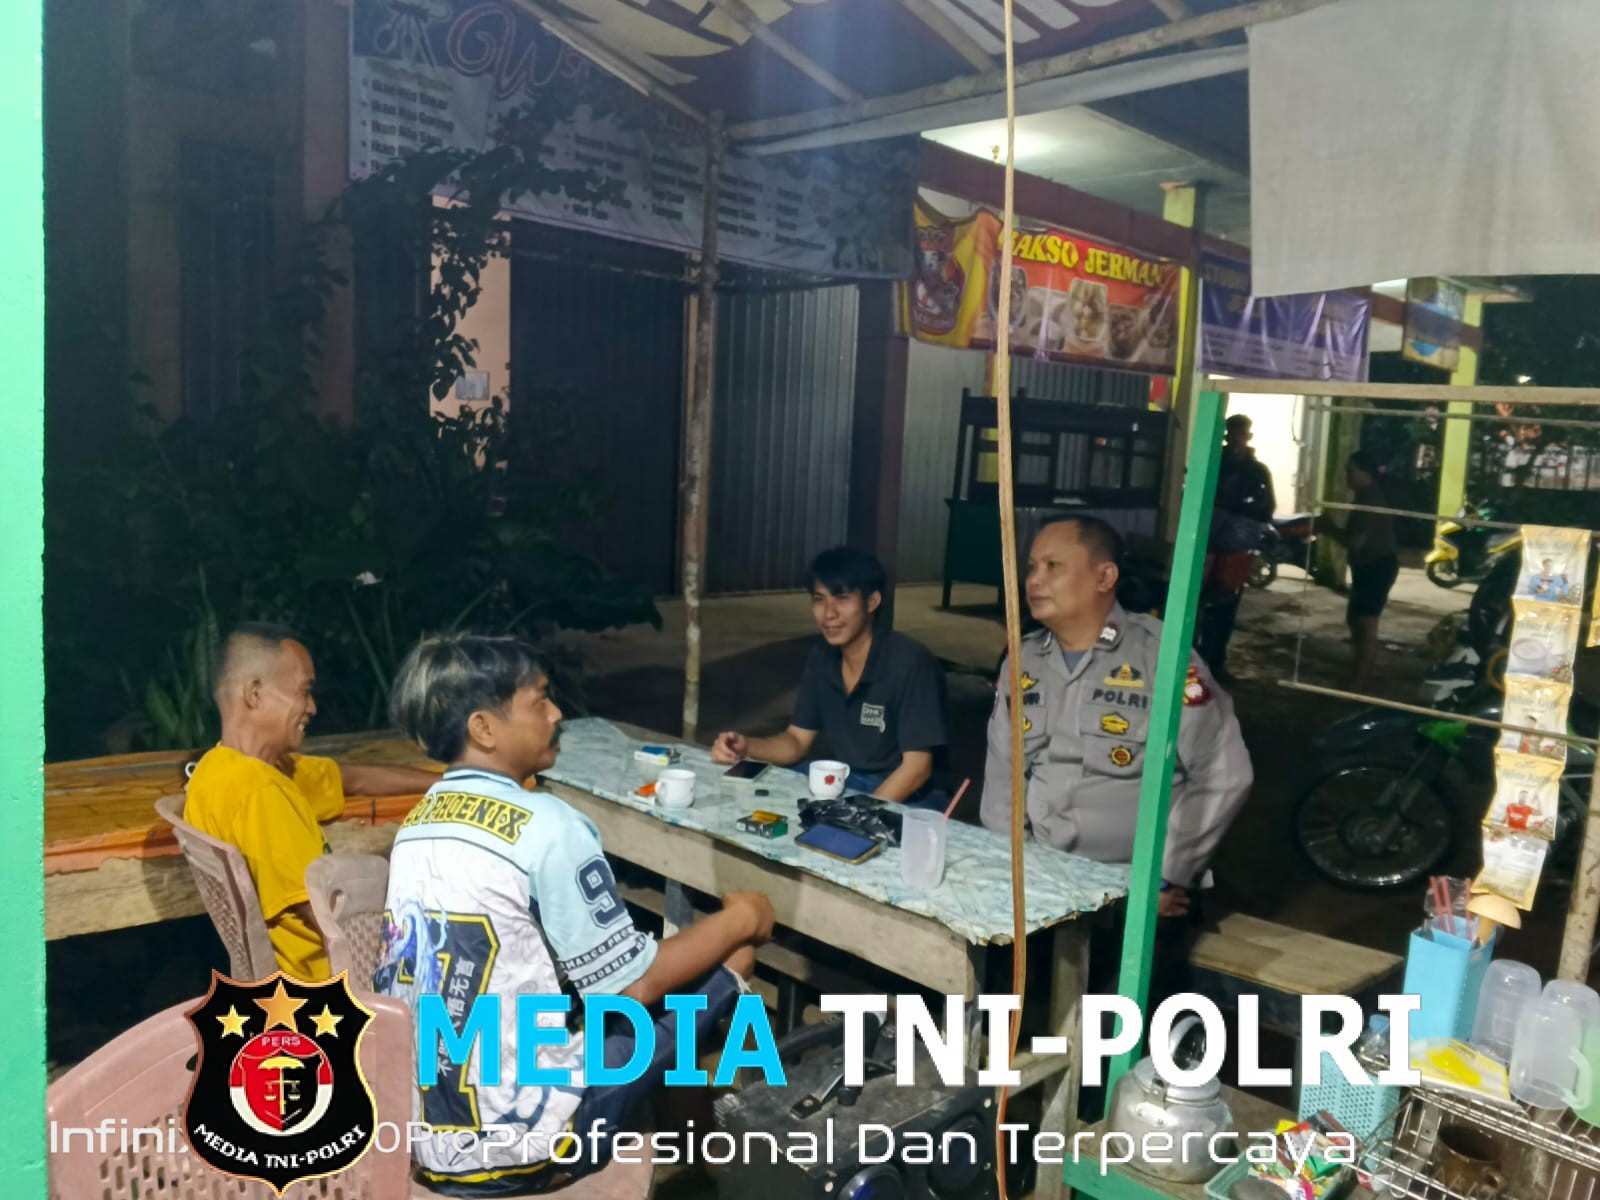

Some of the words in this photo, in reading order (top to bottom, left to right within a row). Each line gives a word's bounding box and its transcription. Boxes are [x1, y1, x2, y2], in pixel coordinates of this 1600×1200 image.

[1084, 247, 1162, 287] JERMAN
[1091, 687, 1149, 710] POLRI
[431, 791, 533, 845] PHOENIX
[576, 855, 627, 930] 9
[565, 944, 608, 971] MARCO
[580, 951, 634, 987] PHOENIX
